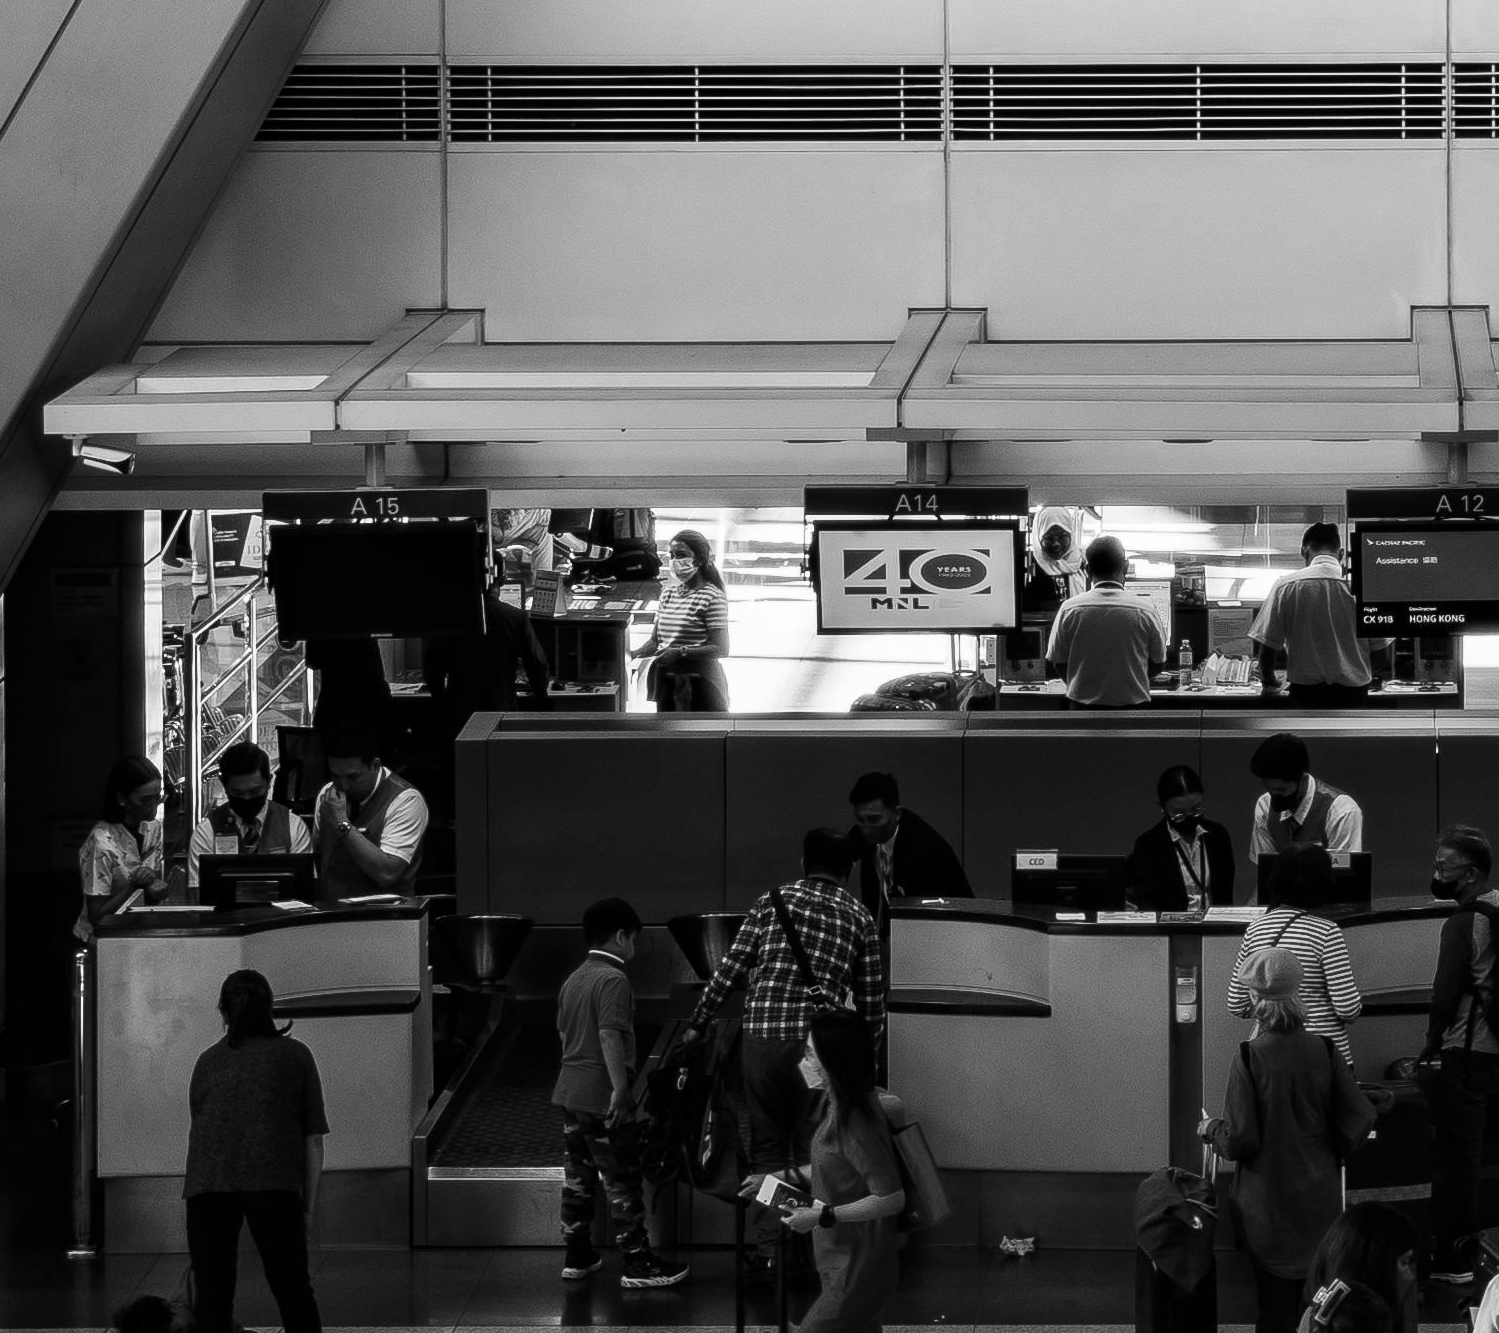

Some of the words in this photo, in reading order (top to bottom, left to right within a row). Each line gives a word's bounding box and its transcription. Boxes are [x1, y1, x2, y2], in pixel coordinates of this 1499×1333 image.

[376, 496, 400, 514] 15
[895, 494, 939, 512] A14
[1460, 494, 1485, 513] 12
[1375, 556, 1419, 565] Assistance
[1363, 615, 1376, 624] CX
[1409, 614, 1437, 623] HONG
[1439, 614, 1465, 623] KONG
